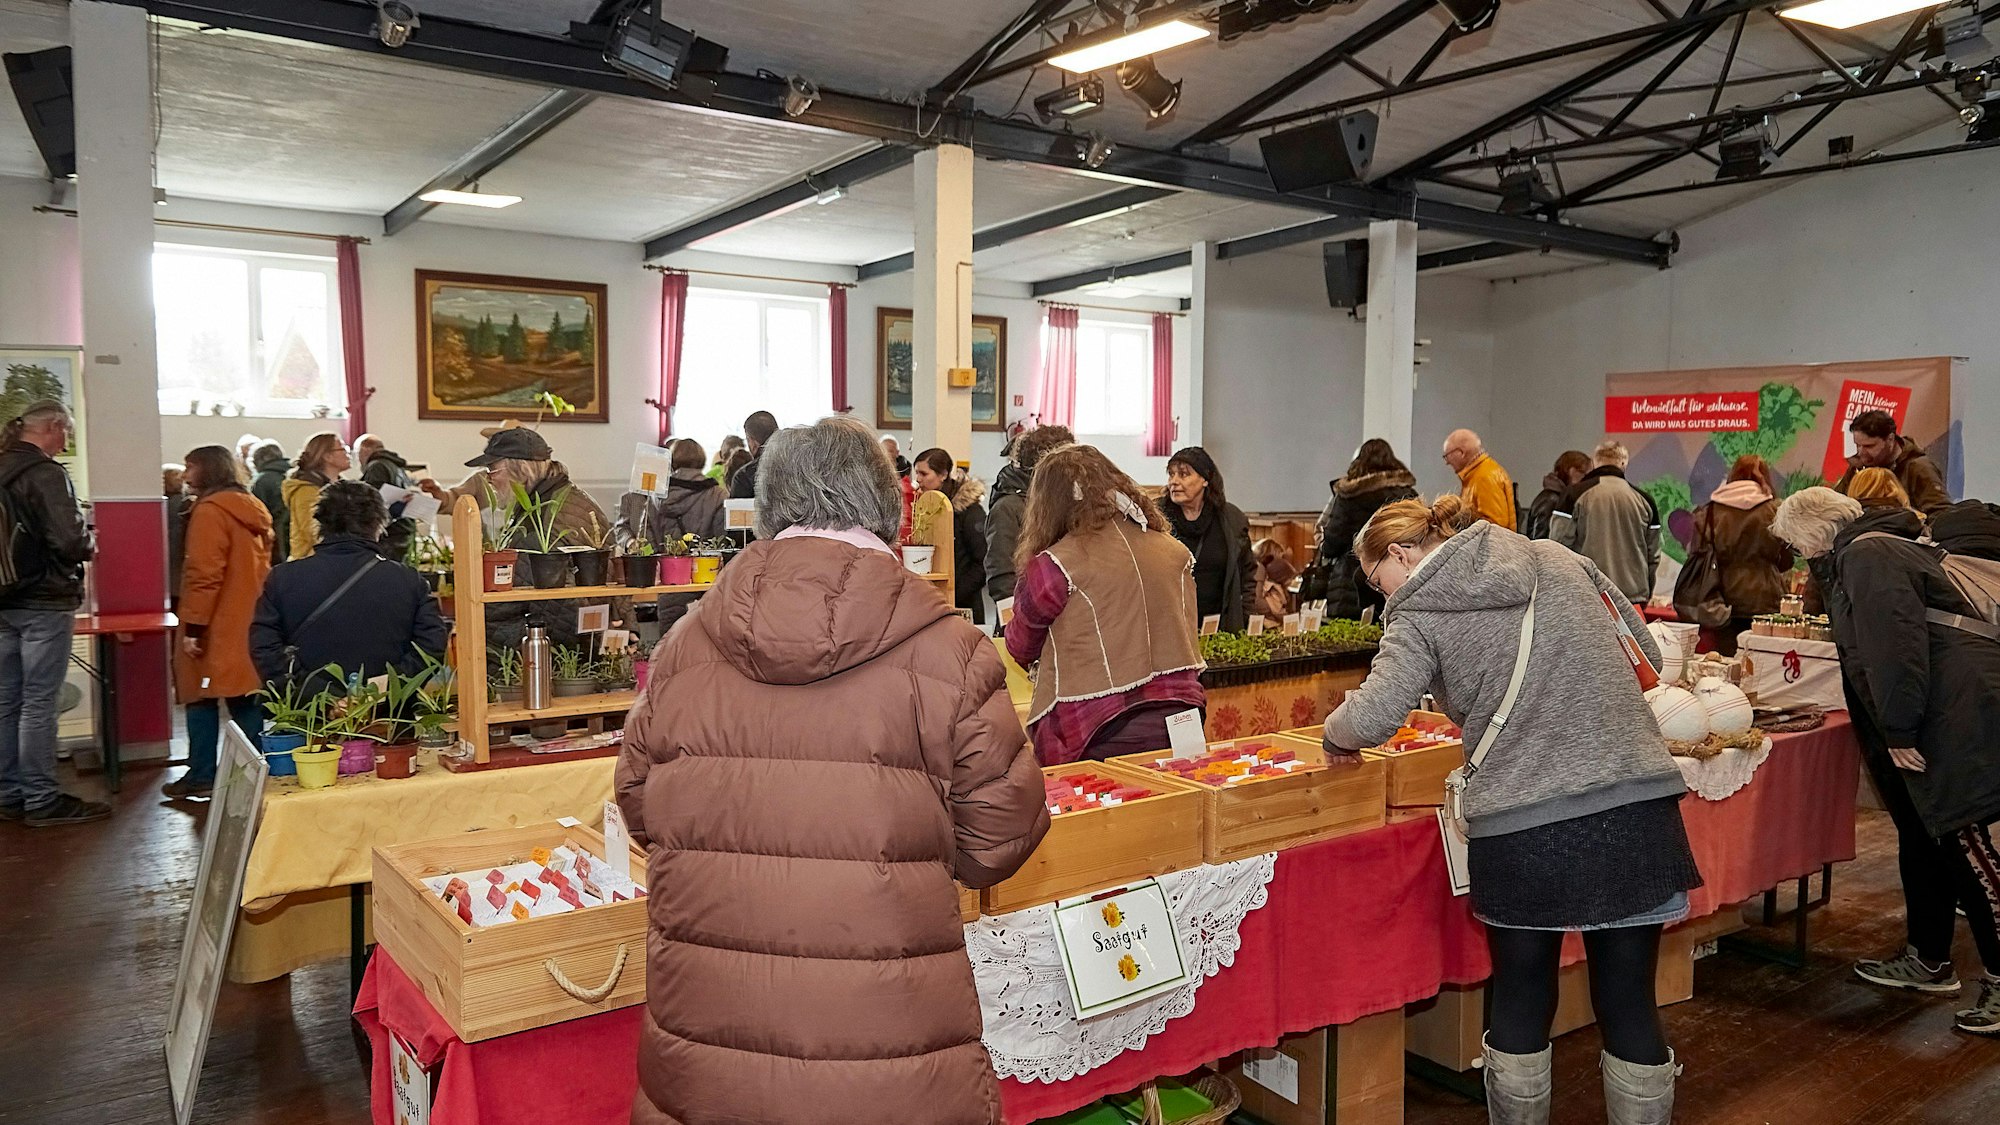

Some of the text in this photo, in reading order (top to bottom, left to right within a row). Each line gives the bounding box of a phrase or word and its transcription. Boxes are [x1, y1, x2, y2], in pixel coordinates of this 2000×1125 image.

[1849, 388, 1875, 405] MEIN
[1874, 397, 1898, 408] kleiner
[1688, 398, 1705, 415] für
[1632, 419, 1750, 429] DA WIRD WAS GUTES DRAUS.
[1092, 923, 1148, 953] Saatgut
